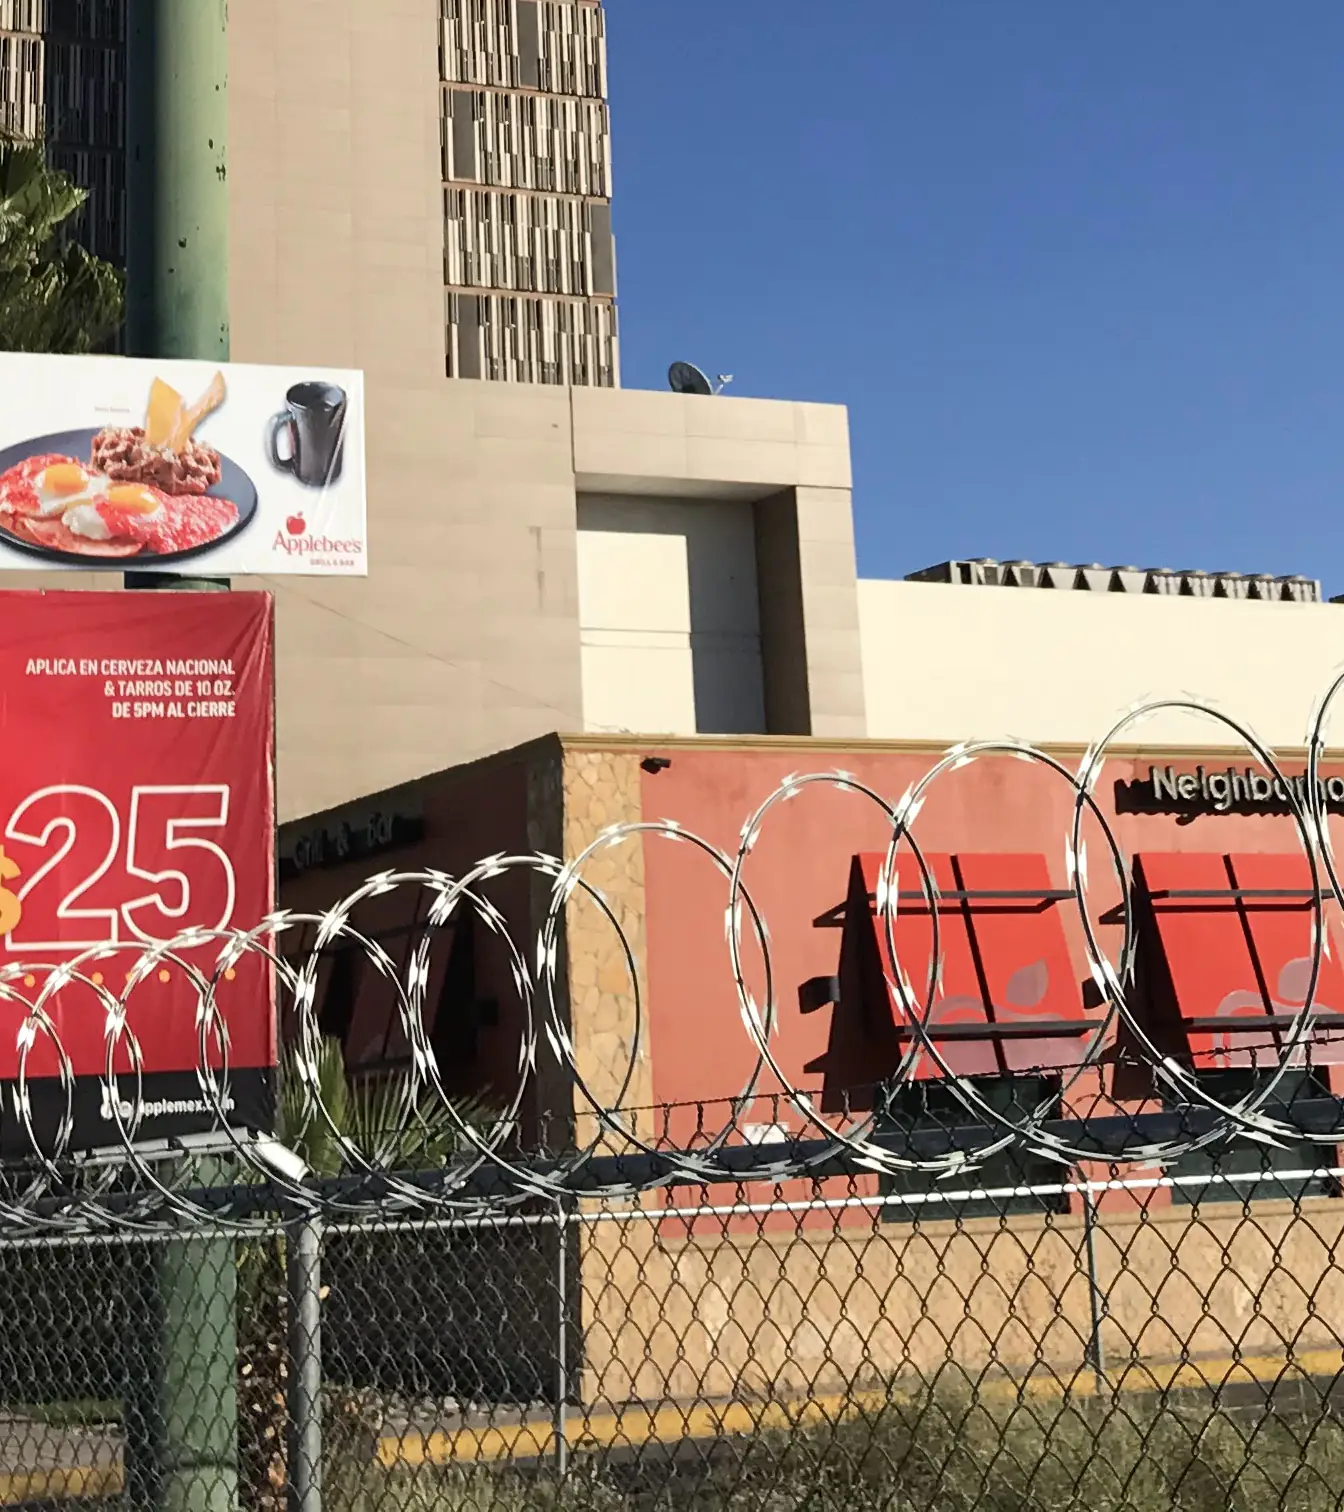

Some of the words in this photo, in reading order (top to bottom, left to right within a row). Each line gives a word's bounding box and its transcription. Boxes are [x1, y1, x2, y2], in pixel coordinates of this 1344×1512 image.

[272, 529, 363, 556] Applebee's
[25, 658, 77, 676] APLICA
[79, 659, 98, 676] EN
[101, 658, 164, 676] CERVEZA
[166, 658, 236, 676] NACIONAL
[104, 680, 115, 697] &
[118, 680, 172, 697] TARROS
[174, 680, 194, 697] DE
[196, 680, 211, 697] 10
[213, 680, 236, 697] OZ.
[112, 701, 131, 718] DE
[133, 701, 164, 718] 5PM
[167, 701, 185, 718] AL
[187, 700, 236, 718] CIERRE
